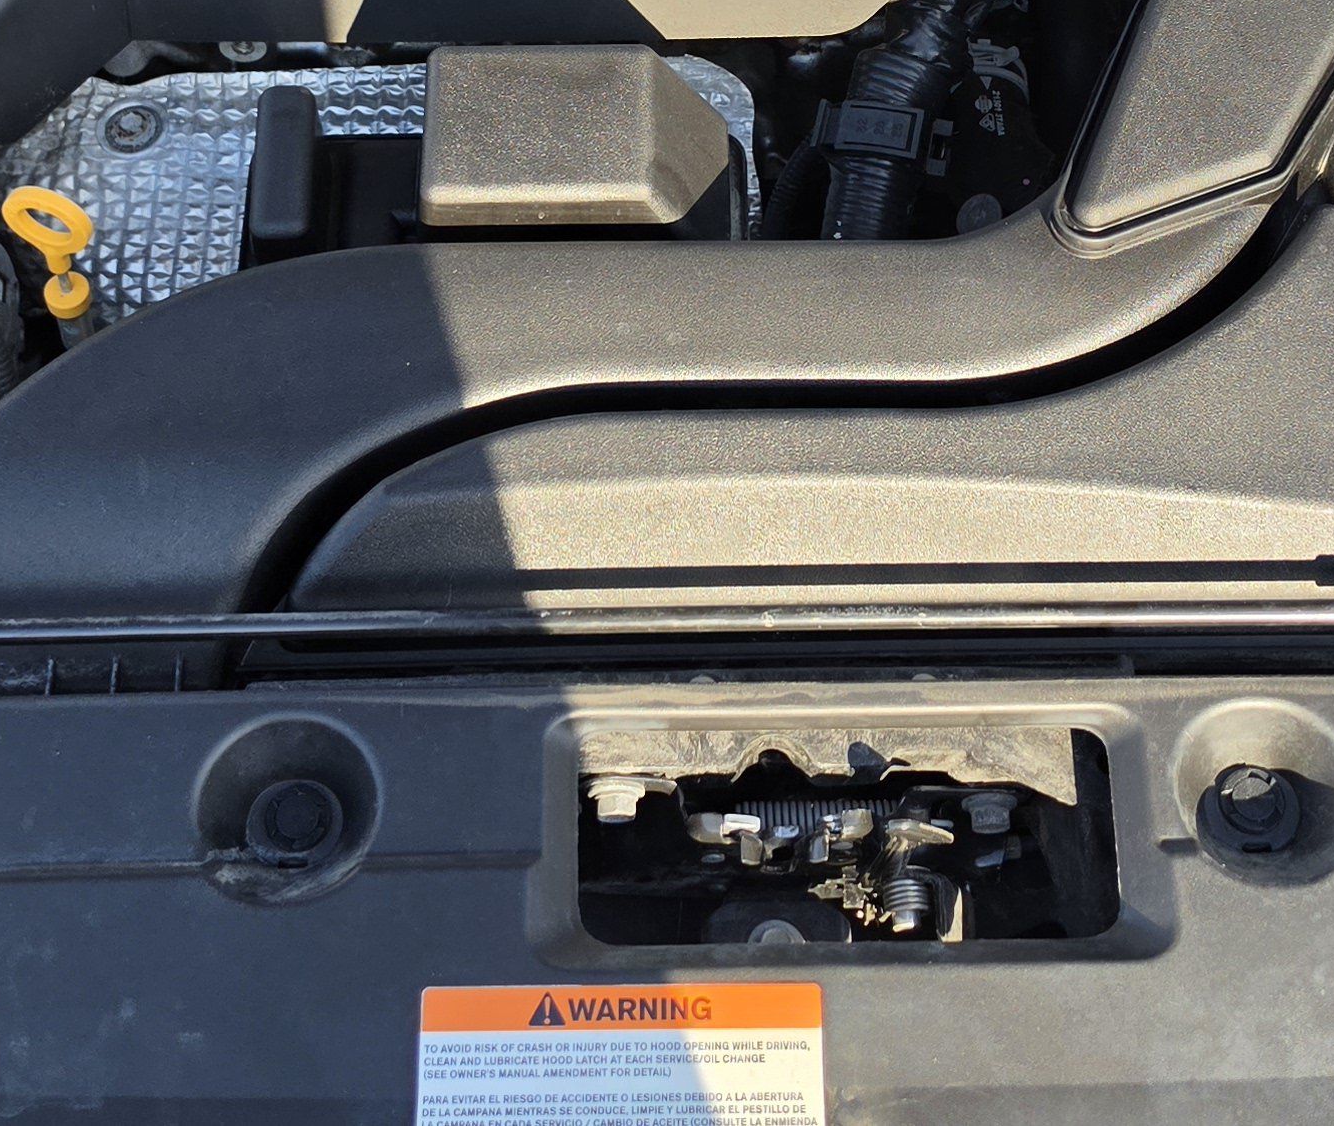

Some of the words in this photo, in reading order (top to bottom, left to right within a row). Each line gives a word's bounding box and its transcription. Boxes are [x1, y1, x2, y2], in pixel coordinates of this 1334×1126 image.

[567, 995, 712, 1022] WARNING
[424, 1044, 438, 1054] TO
[440, 1043, 471, 1053] AVOID
[474, 1043, 497, 1053] RISK
[500, 1043, 514, 1053] OF
[516, 1042, 552, 1052] CRASH
[554, 1042, 569, 1052] OR
[572, 1042, 607, 1052] INJURY
[610, 1042, 631, 1051] DUE
[634, 1041, 647, 1051] TO
[650, 1041, 682, 1051] HOOD
[683, 1041, 729, 1050] OPENING
[732, 1040, 763, 1050] WHILE
[765, 1040, 810, 1051] DRIVING,
[423, 1056, 457, 1066] CLEAN
[459, 1056, 481, 1066] AND
[484, 1055, 539, 1065] LUBRICATE
[541, 1055, 573, 1065] HOOD
[575, 1054, 607, 1064] LATCH
[609, 1054, 622, 1064] AT
[625, 1054, 652, 1064] EACH
[655, 1054, 720, 1064] SERVICE/OIL
[722, 1053, 765, 1063] CHANGE
[423, 1069, 446, 1080] (SEE
[449, 1069, 495, 1079] OWNER'S
[498, 1068, 540, 1078] MANUAL
[542, 1067, 607, 1077] AMENDMENT
[610, 1067, 630, 1077] FOR
[633, 1067, 671, 1078] DETAIL)
[422, 1095, 448, 1104] PARA
[451, 1094, 485, 1104] EVITAR
[488, 1094, 500, 1104] EL
[502, 1093, 542, 1104] RIESGO
[544, 1093, 558, 1103] DE
[560, 1093, 618, 1103] ACCIDENTE
[631, 1092, 681, 1102] LESIONES
[684, 1091, 722, 1103] DEBIDO
[734, 1092, 747, 1101] LA
[749, 1091, 803, 1101] ABERTURA
[421, 1108, 435, 1117] DE
[438, 1108, 450, 1117] LA
[453, 1107, 502, 1116] CAMPANA
[504, 1106, 556, 1116] MIENTRAS
[558, 1106, 572, 1115] SE
[574, 1105, 628, 1115] CONDUCE,
[631, 1105, 664, 1114] LIMPIE
[675, 1104, 725, 1115] LUBRICAR
[727, 1104, 739, 1114] EL
[742, 1104, 790, 1114] PESTILLO
[792, 1104, 806, 1113] DE
[764, 1118, 817, 1126] ENMIENDA
